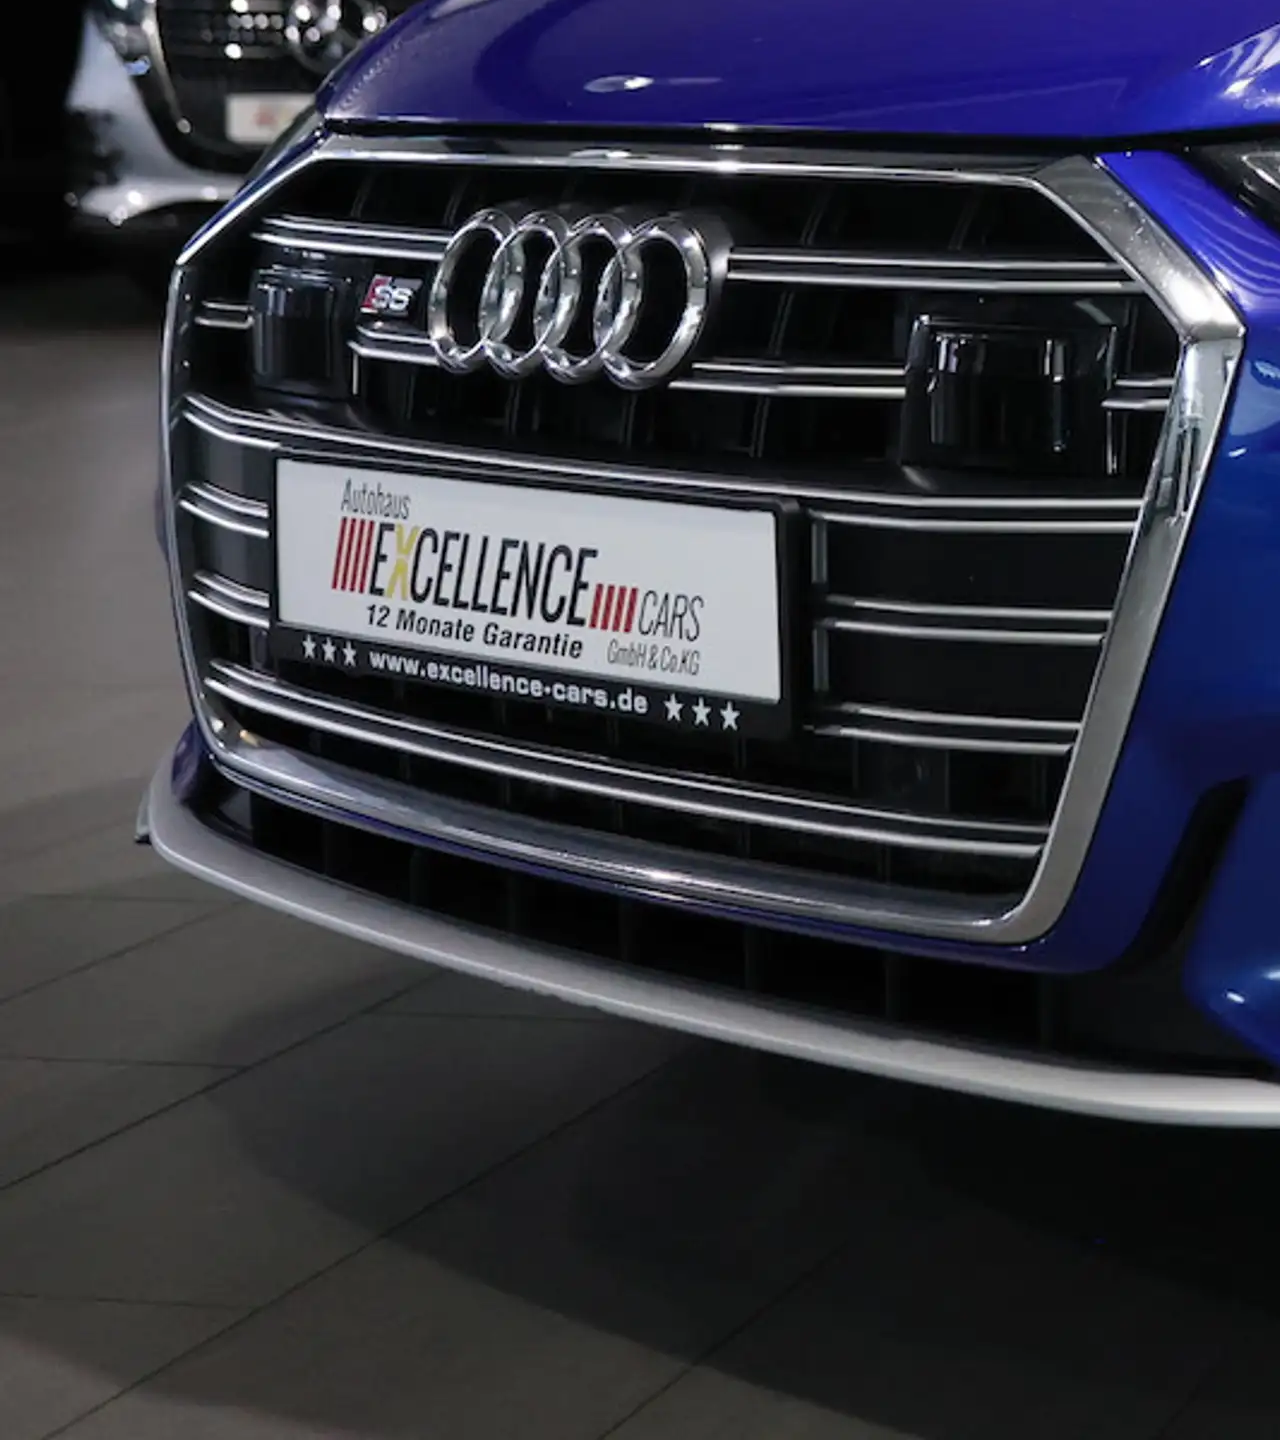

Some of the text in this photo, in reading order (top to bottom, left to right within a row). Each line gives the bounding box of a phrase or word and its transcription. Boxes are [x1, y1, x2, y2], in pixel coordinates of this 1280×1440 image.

[369, 283, 415, 313] S6
[340, 477, 412, 520] Autohaus
[369, 522, 705, 642] EXCELLENCE CARS
[366, 604, 584, 659] 12 Monate Garantie
[606, 638, 647, 667] GmbH
[649, 643, 659, 671] &
[368, 649, 649, 714] www.excellence-cars.de
